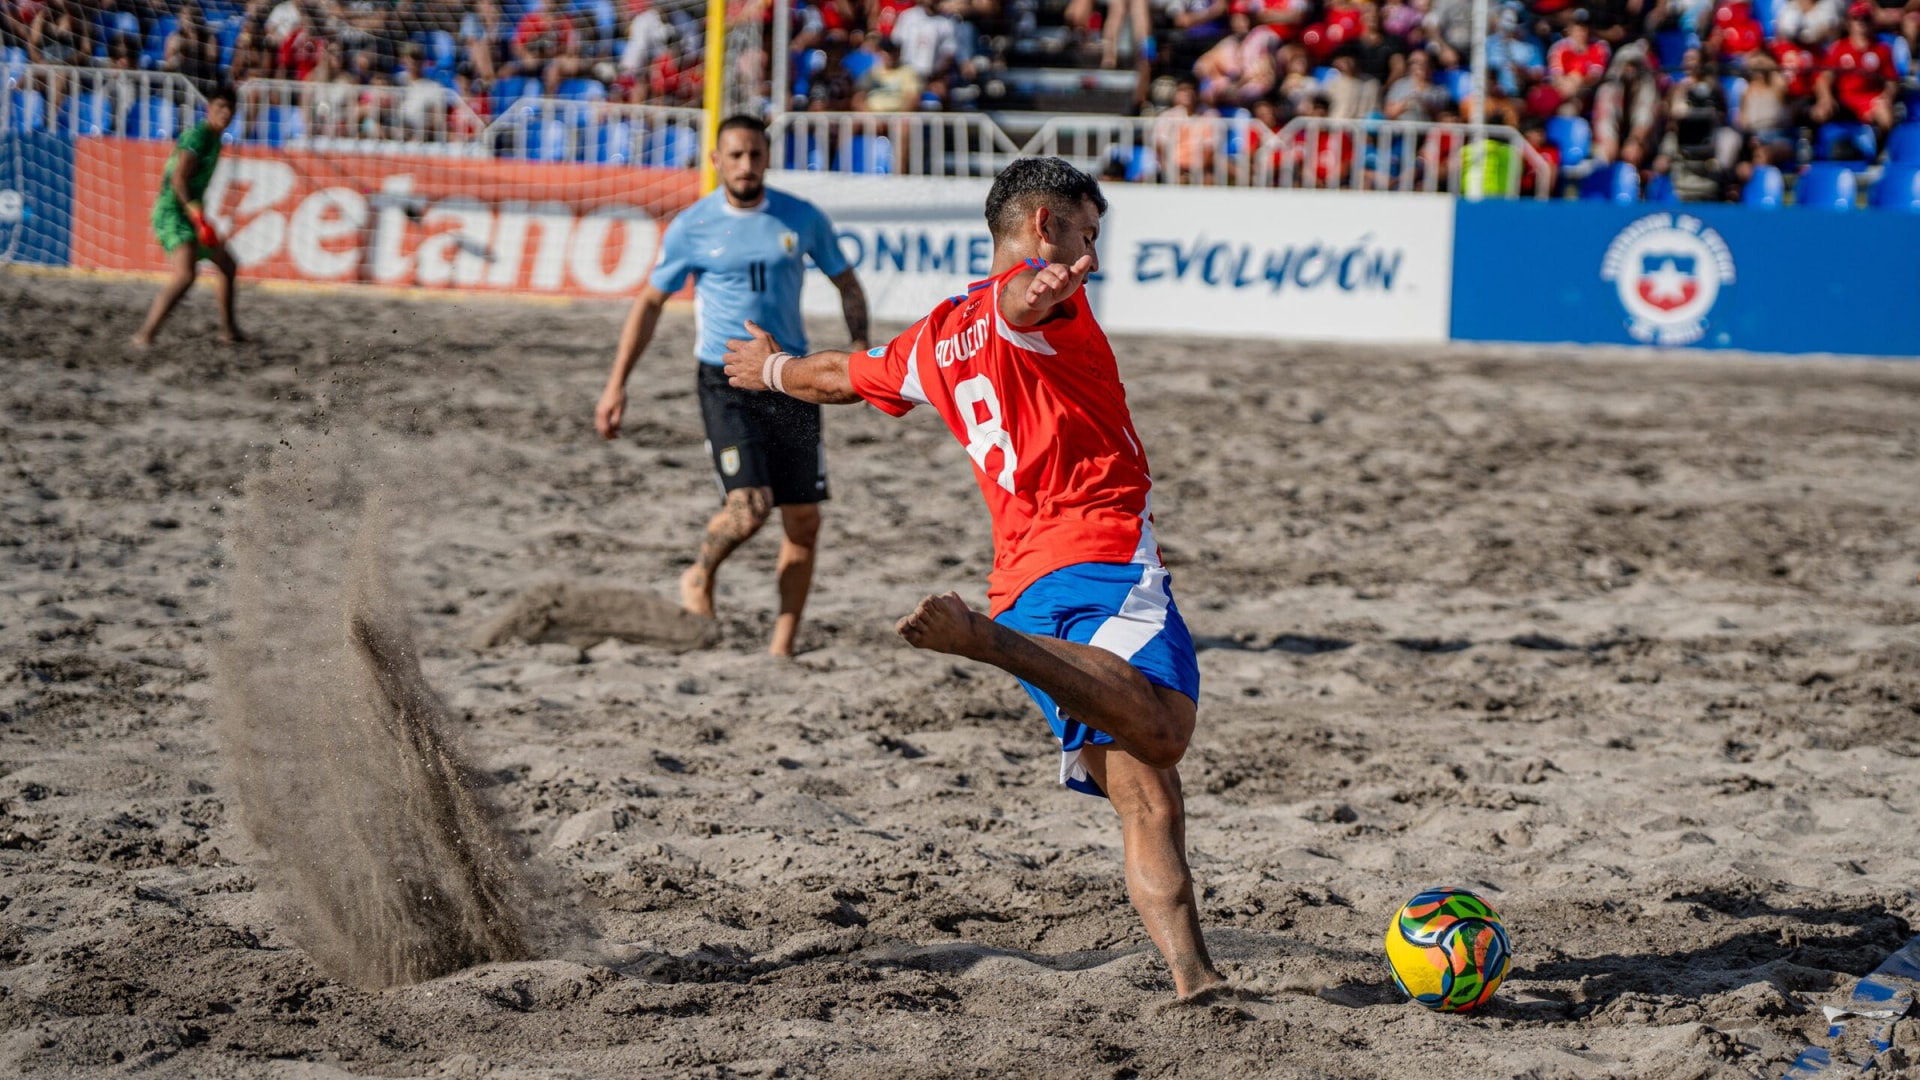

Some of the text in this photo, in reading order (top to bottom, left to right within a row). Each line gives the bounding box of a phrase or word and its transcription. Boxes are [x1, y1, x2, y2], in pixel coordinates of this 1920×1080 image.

[205, 157, 658, 294] Betano
[751, 261, 766, 293] 11
[955, 373, 1018, 496] 8
